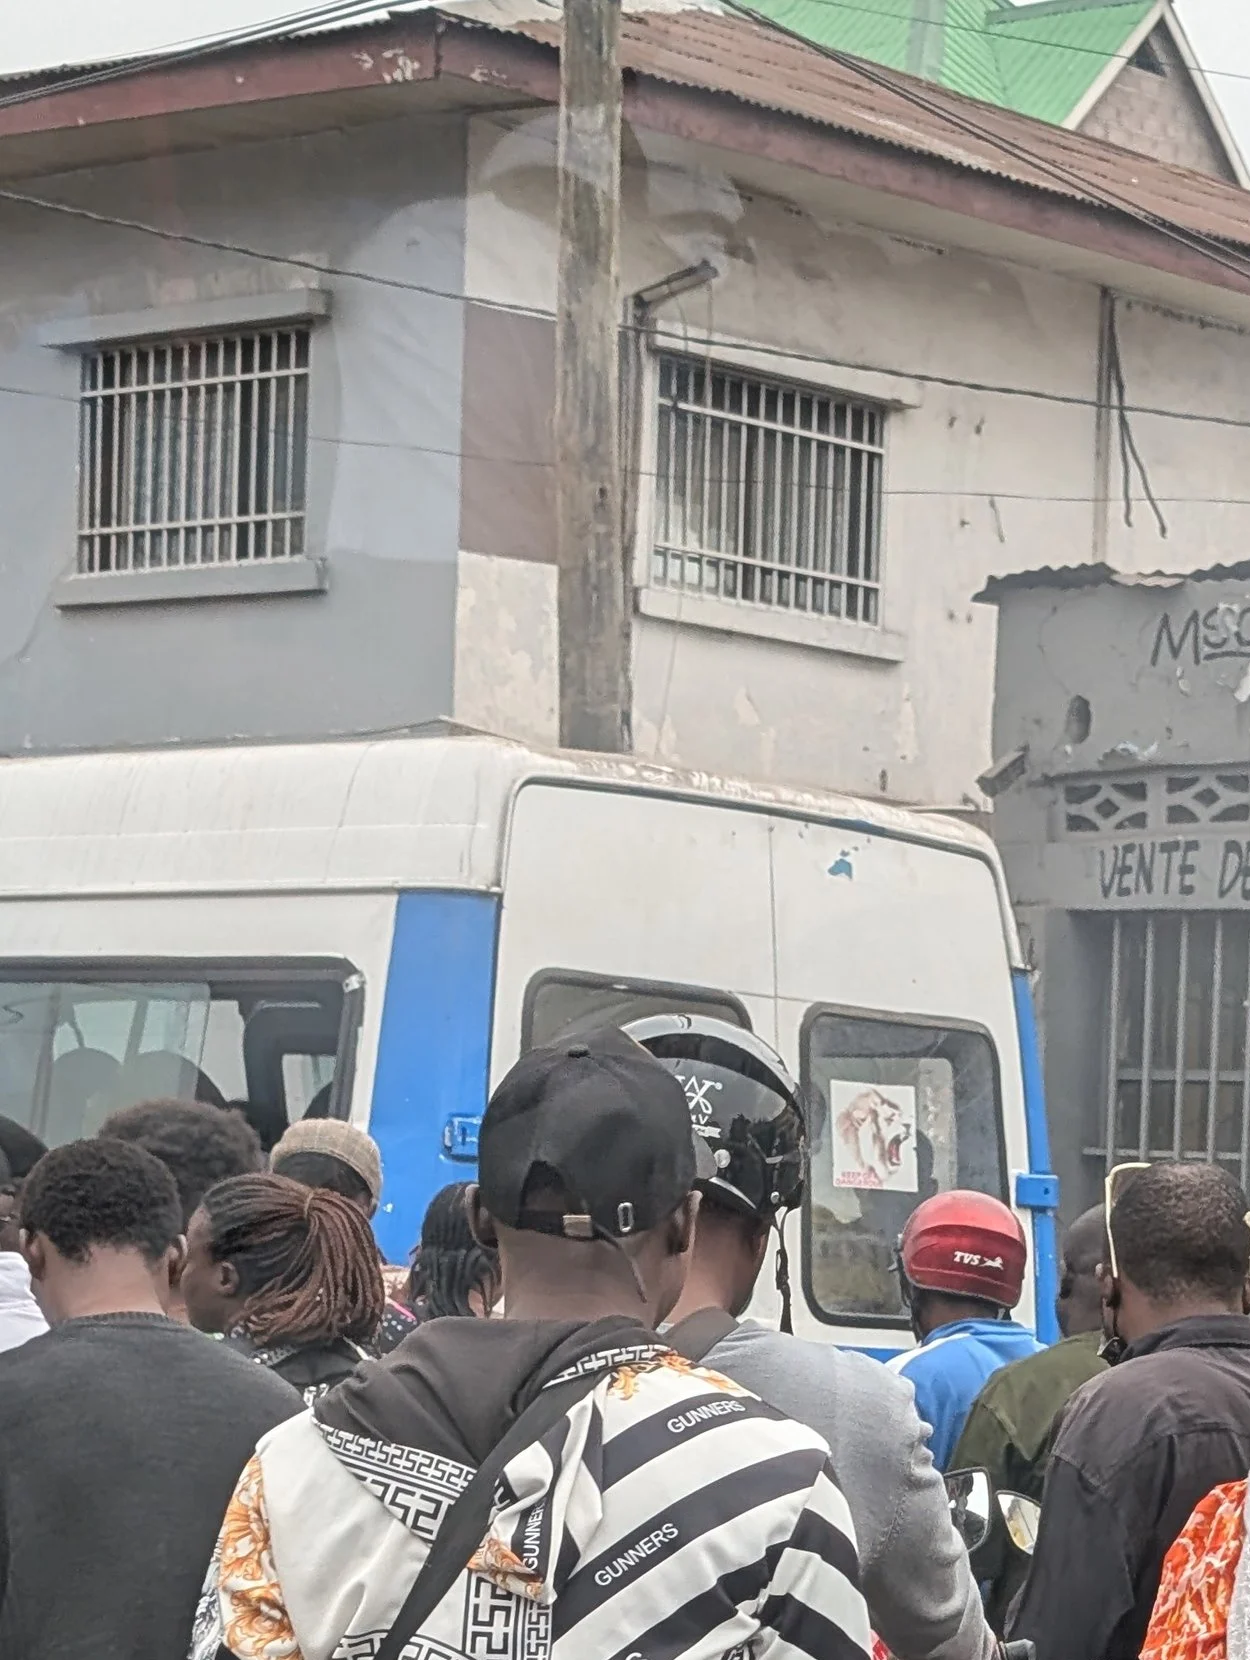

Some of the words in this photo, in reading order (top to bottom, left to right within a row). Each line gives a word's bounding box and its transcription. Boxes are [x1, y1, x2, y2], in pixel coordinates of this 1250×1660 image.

[1100, 838, 1197, 899] VENTE
[953, 1250, 982, 1266] TVS
[666, 1398, 746, 1435] GUNNERS
[593, 1522, 679, 1588] GUNNERS
